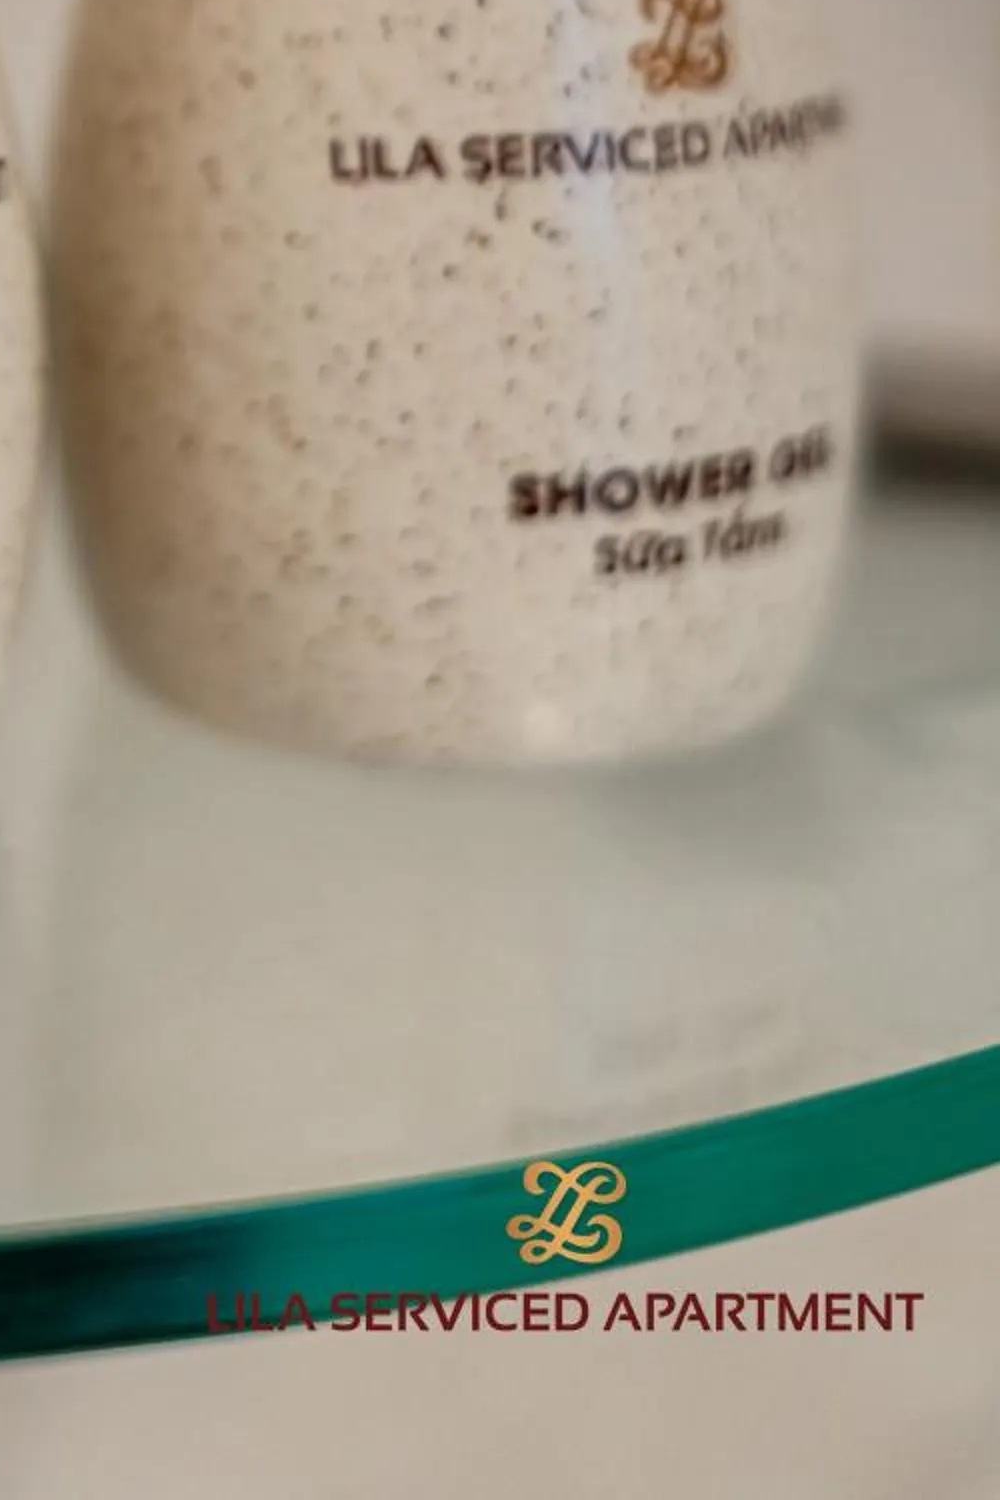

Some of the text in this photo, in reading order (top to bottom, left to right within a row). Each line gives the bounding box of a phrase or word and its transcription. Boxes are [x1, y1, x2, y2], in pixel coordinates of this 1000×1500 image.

[329, 134, 444, 184] LILA
[459, 118, 712, 180] SERVICED
[507, 447, 755, 520] SHOWER
